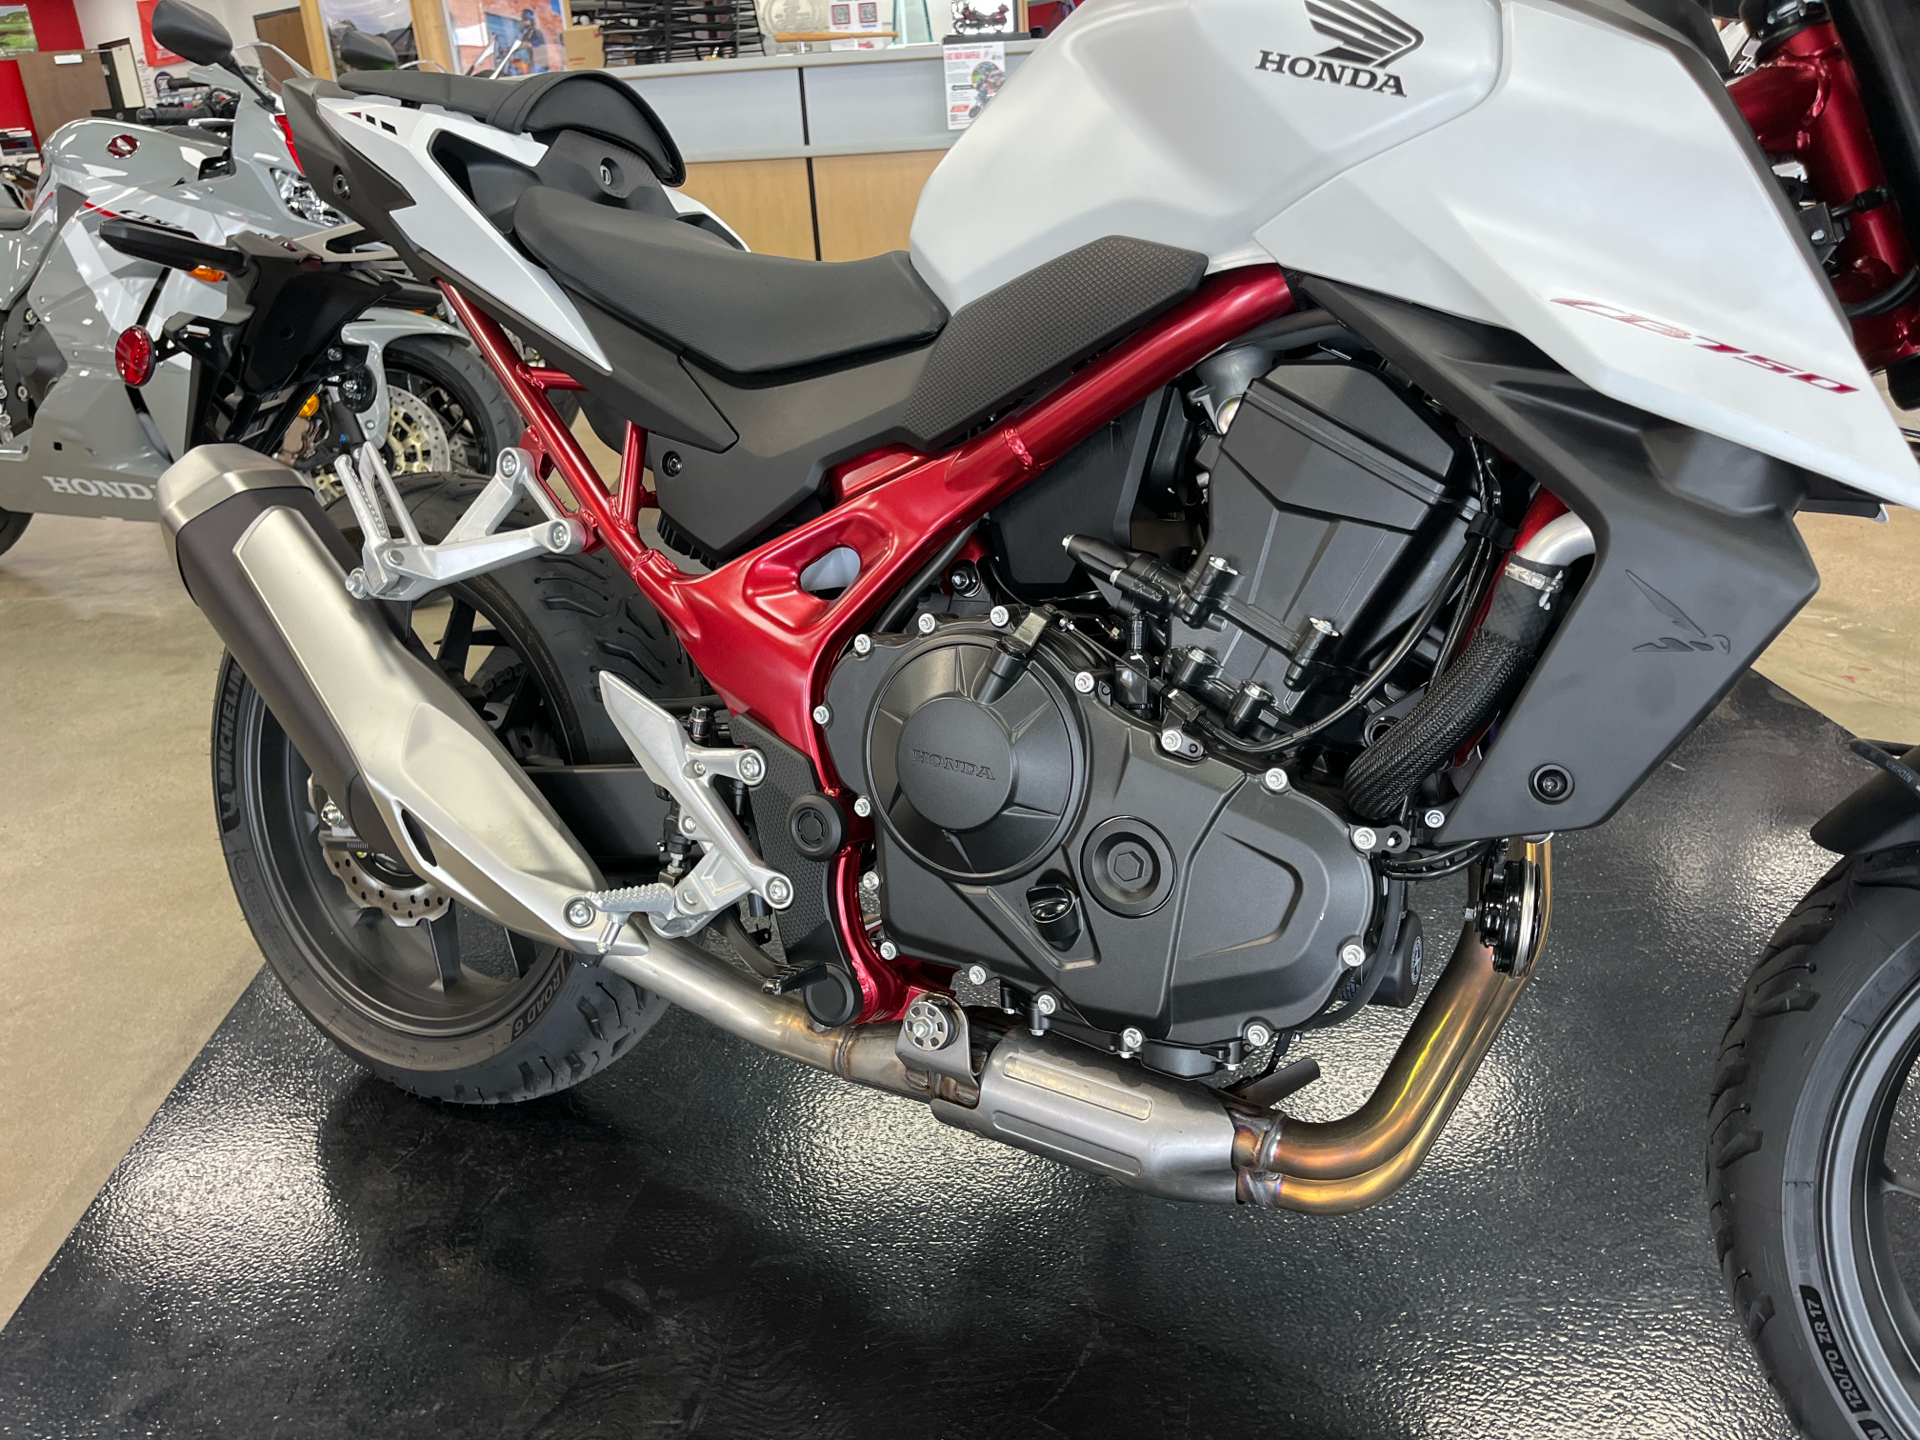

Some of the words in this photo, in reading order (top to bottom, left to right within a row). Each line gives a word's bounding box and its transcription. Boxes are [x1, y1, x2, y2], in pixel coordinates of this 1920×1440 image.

[1255, 50, 1407, 98] HONDA
[42, 475, 157, 501] HOND
[220, 661, 244, 785] MICHELIN
[912, 748, 996, 781] HONDA
[527, 969, 560, 1023] ROAD
[514, 1018, 524, 1036] 6
[1806, 1298, 1823, 1318] 17
[1813, 1321, 1833, 1344] ZR
[1825, 1349, 1862, 1408] 120/70
